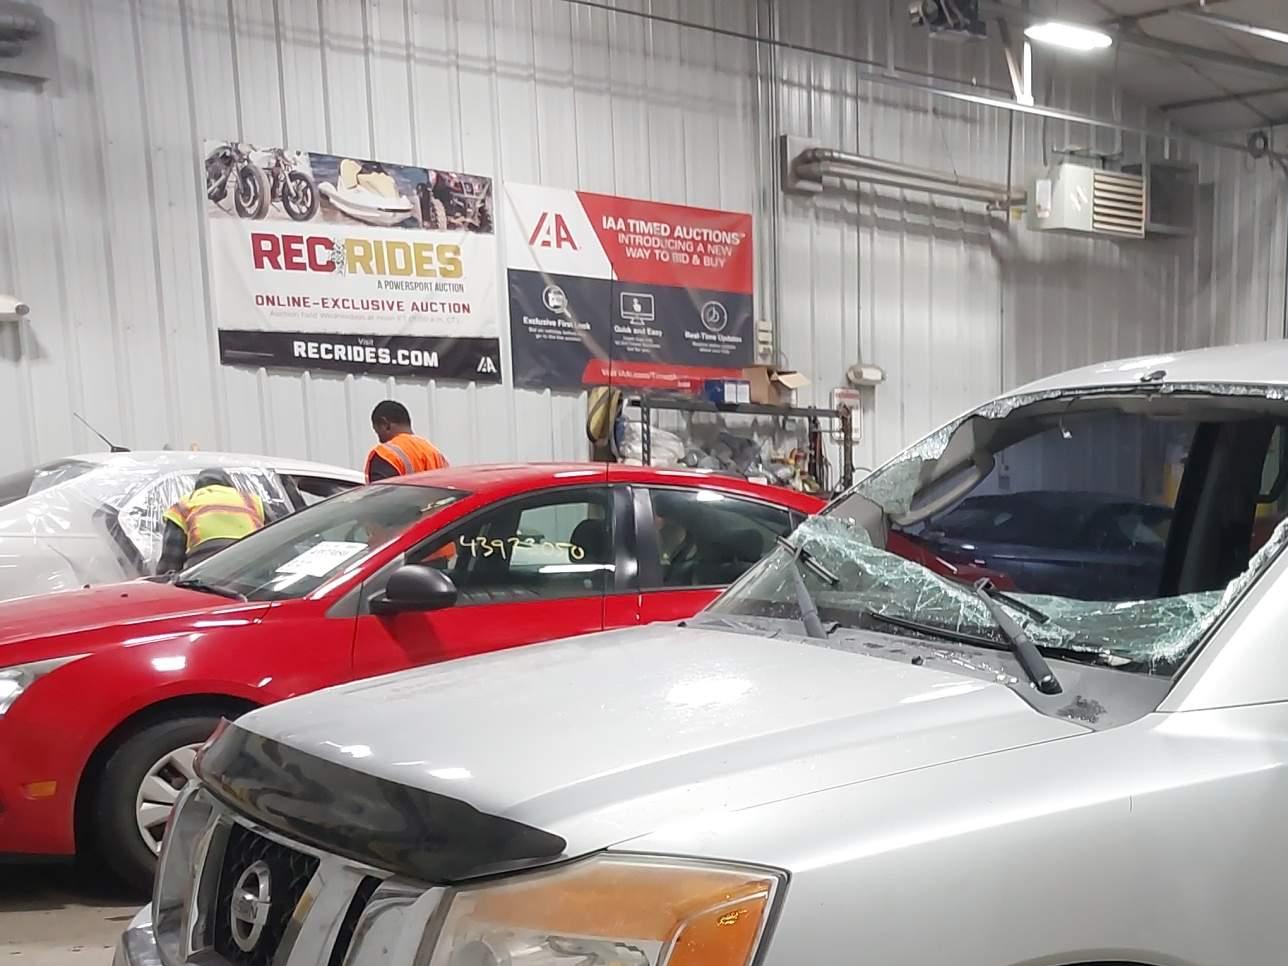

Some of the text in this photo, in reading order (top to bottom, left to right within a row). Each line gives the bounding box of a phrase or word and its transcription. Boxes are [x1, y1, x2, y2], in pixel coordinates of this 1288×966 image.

[602, 216, 626, 231] IAA
[627, 219, 670, 236] TIMED
[251, 232, 464, 279] REC RIDES
[618, 234, 733, 257] INTRODUCING A NEW
[625, 246, 651, 259] WAY
[654, 250, 670, 262] TO
[692, 254, 701, 265] &
[704, 256, 727, 267] BUY
[377, 280, 464, 293] A POWERSPORT AUCTION
[255, 295, 471, 314] ONLINE-EXCLUSIVE AUCTION
[358, 337, 374, 346] Visit
[293, 341, 439, 368] RECRIDES.COM
